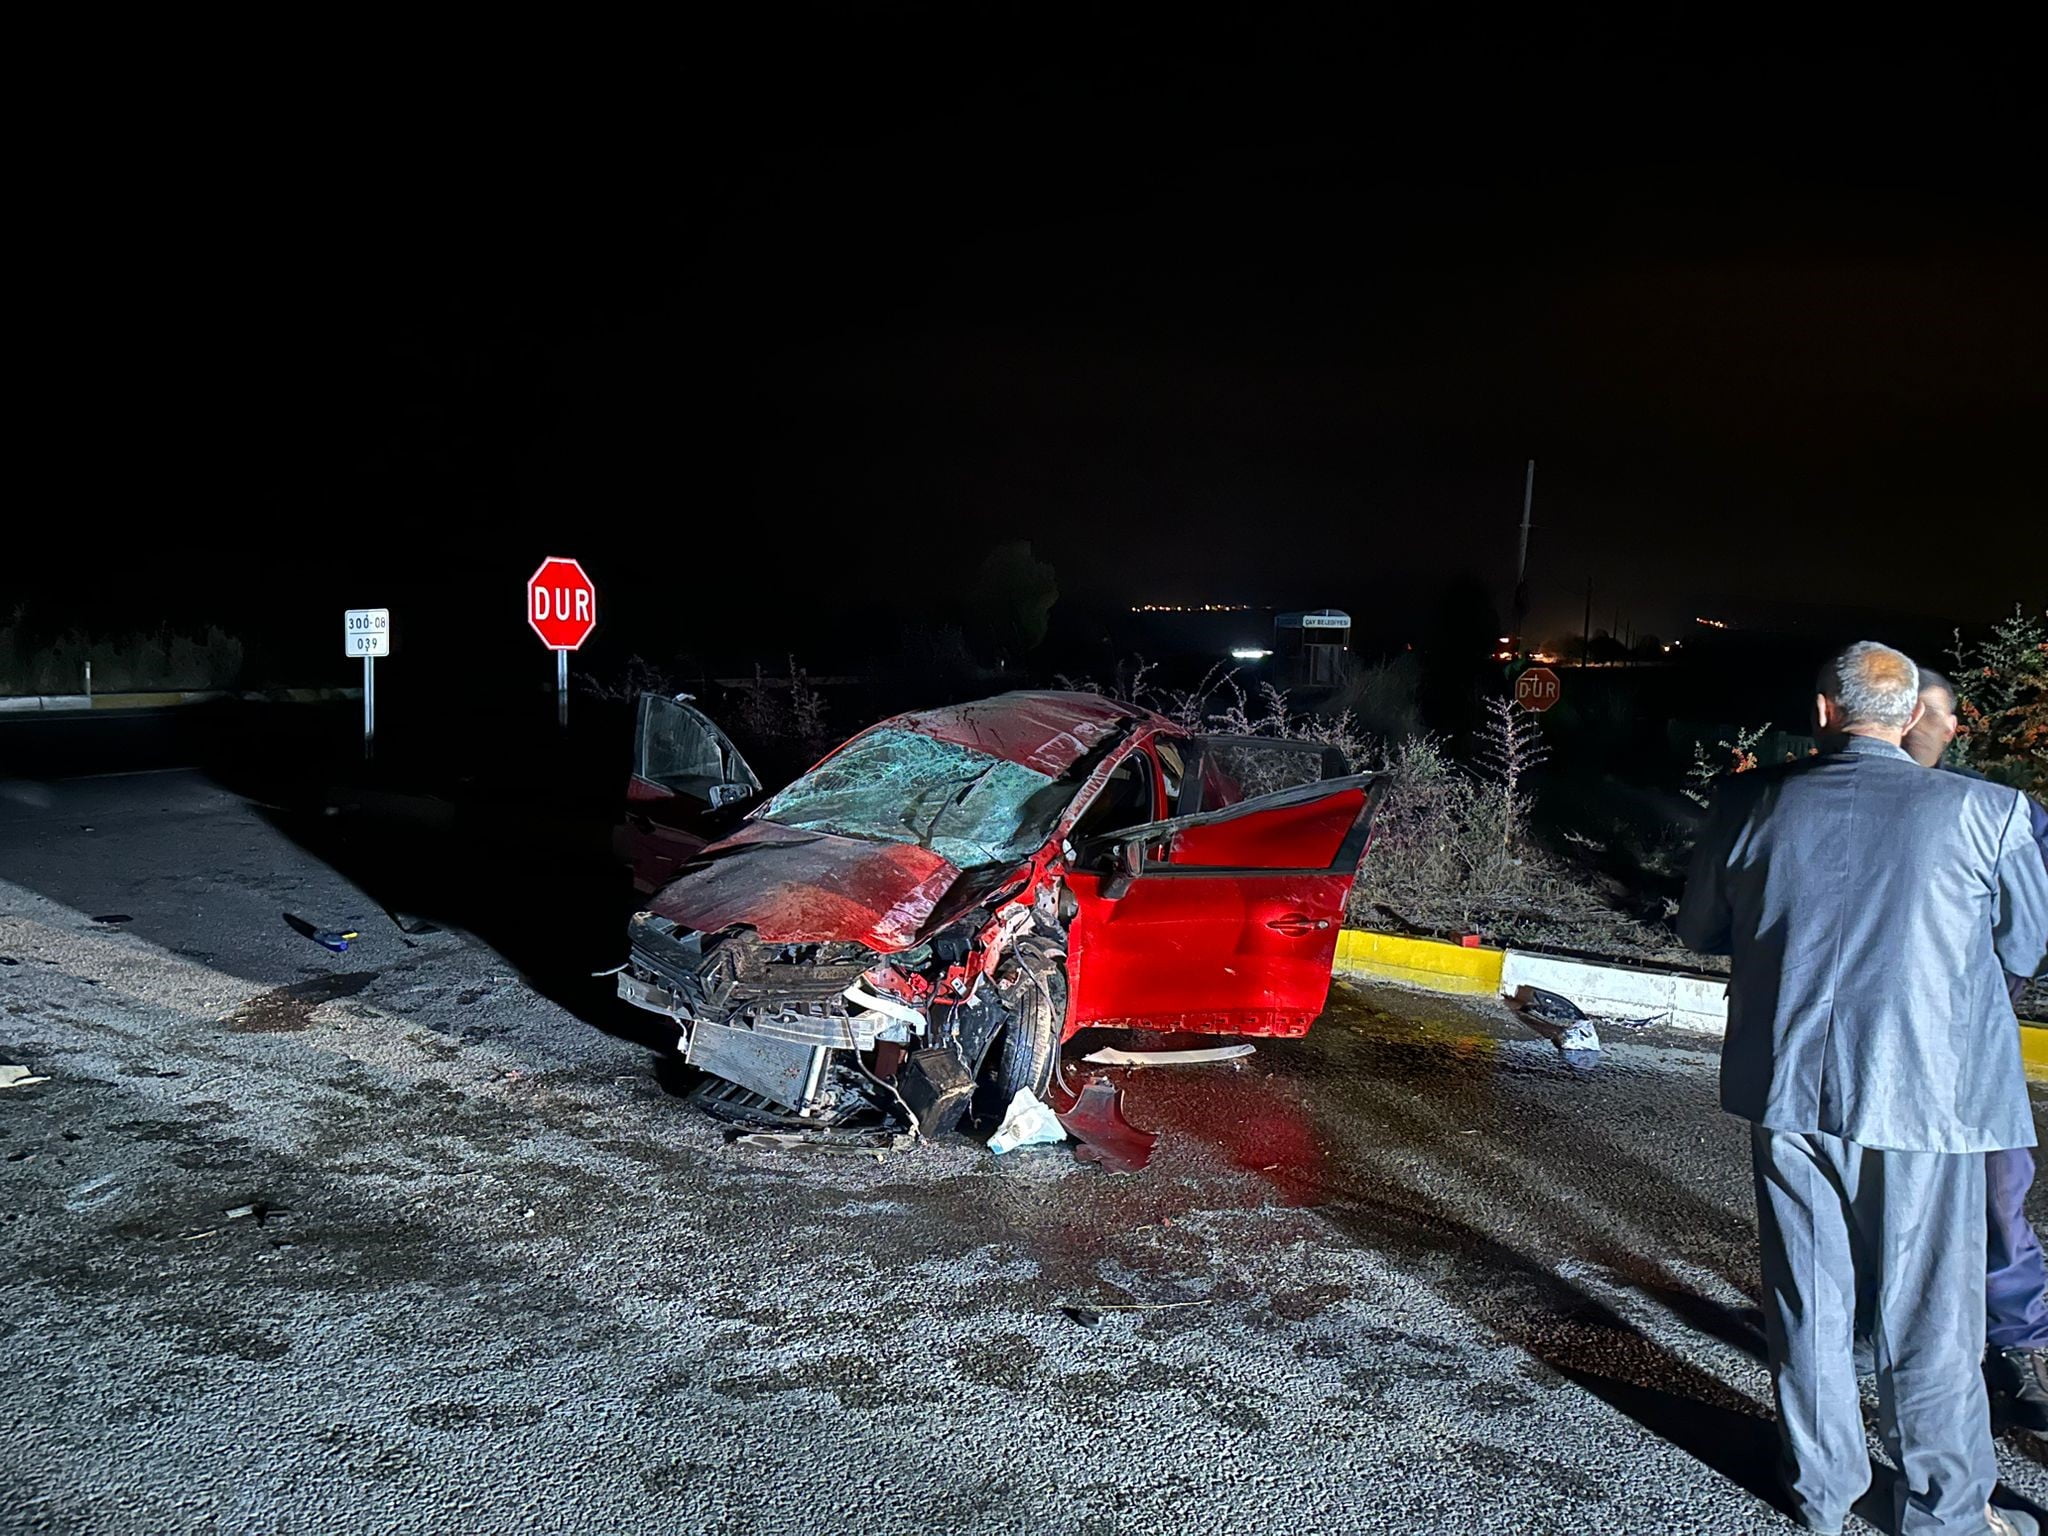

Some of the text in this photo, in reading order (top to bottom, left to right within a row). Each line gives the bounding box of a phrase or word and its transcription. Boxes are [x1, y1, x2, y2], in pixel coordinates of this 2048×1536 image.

[535, 586, 589, 622] DUR
[349, 617, 386, 629] 300-08
[357, 638, 378, 650] 039
[1519, 681, 1556, 698] DUR
